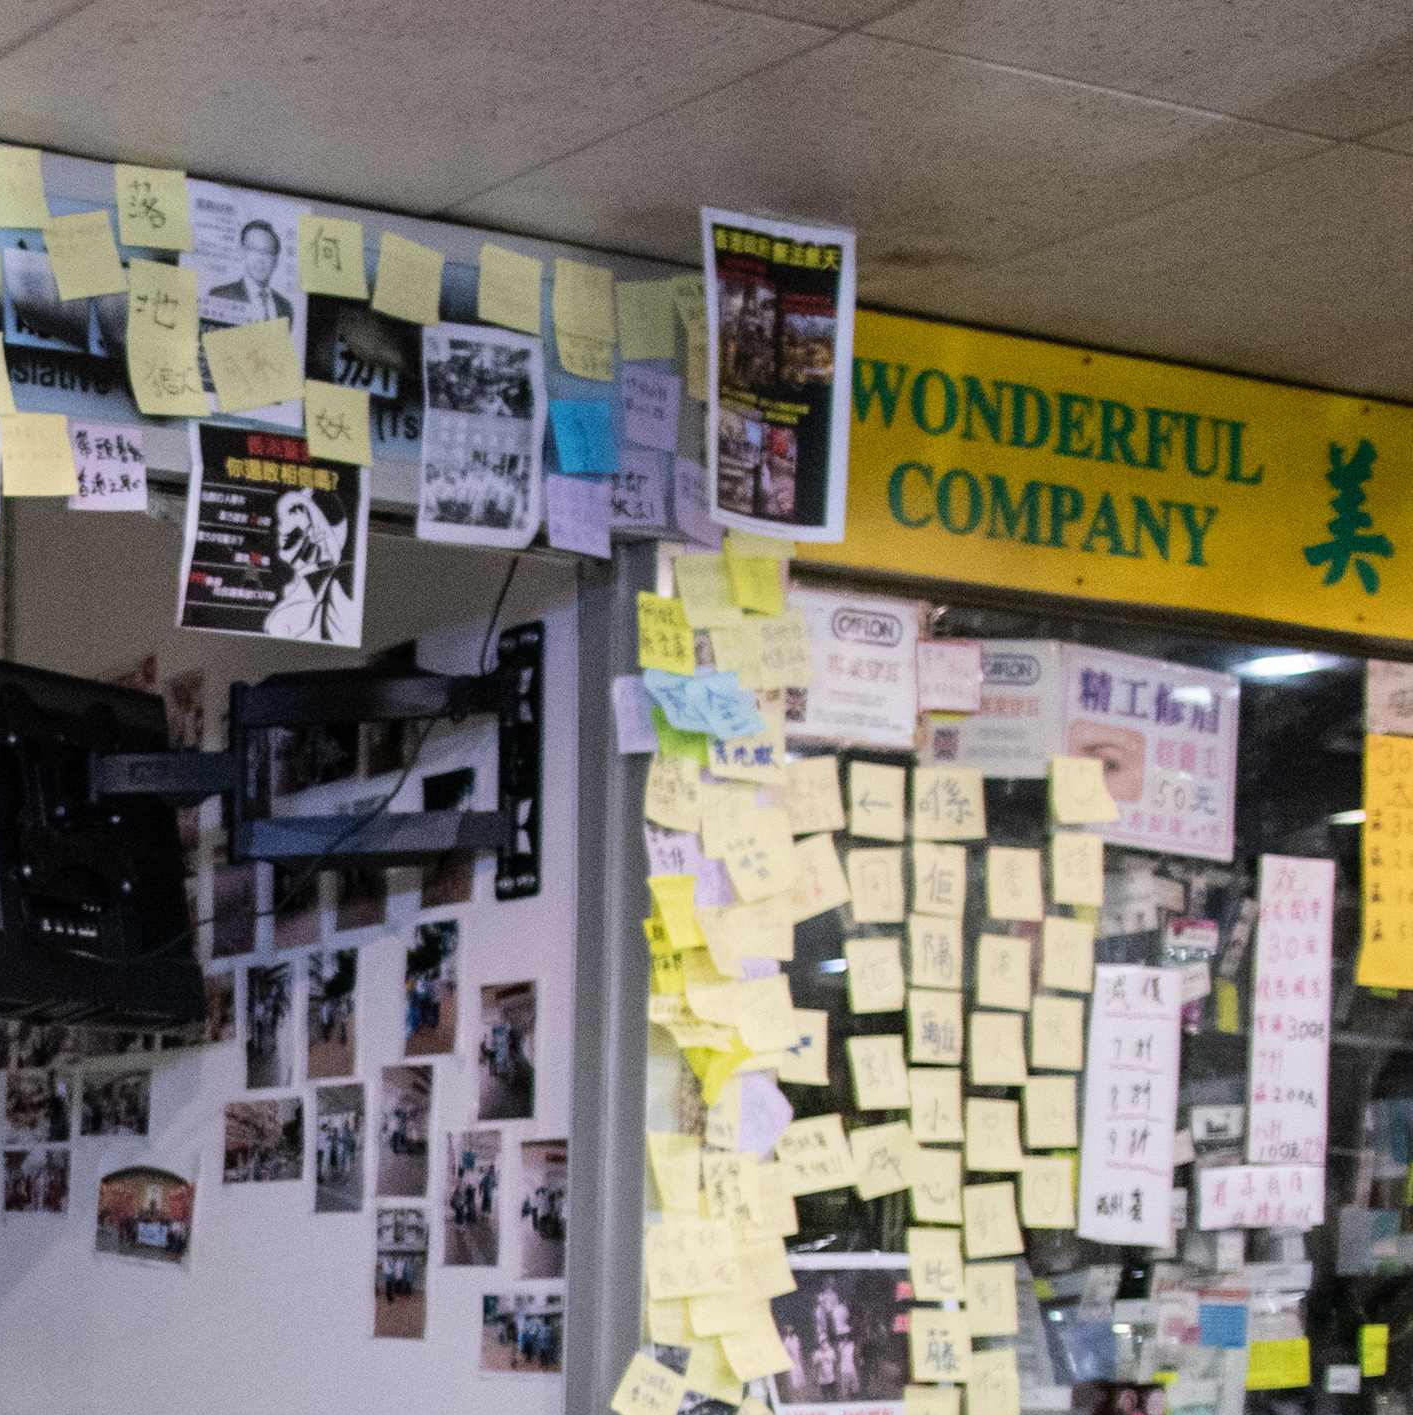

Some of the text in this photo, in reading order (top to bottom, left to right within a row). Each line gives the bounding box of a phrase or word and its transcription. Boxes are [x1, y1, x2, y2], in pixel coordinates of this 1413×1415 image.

[853, 355, 1264, 486] WONDERFUL
[888, 462, 1216, 566] COMPANY
[1305, 439, 1394, 594] 美
